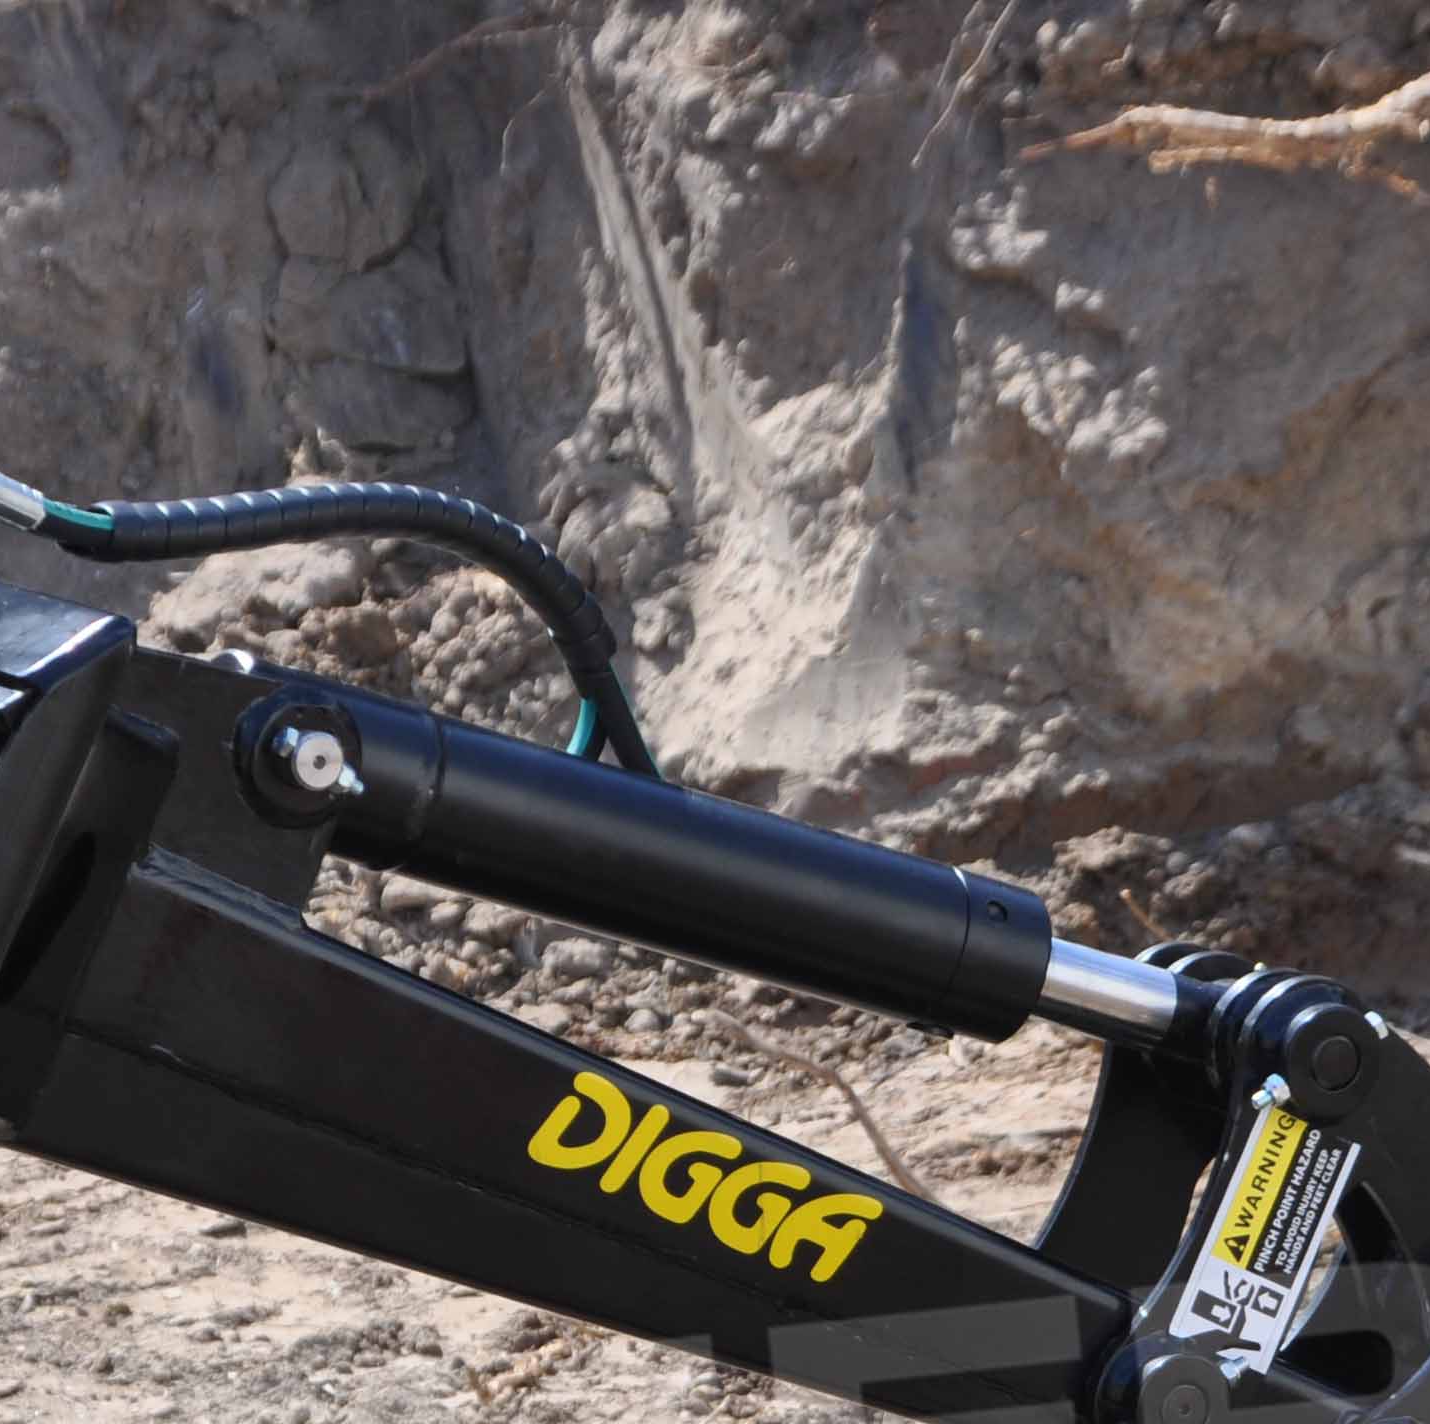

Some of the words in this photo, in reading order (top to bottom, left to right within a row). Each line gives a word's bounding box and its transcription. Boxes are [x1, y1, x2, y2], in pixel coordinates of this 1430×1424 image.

[527, 1071, 884, 1283] DIGGA
[1234, 1114, 1296, 1228] WARNING
[1253, 1229, 1280, 1272] PINCH
[1273, 1185, 1298, 1229] POINT
[1291, 1129, 1321, 1186] HAZARD
[1275, 1250, 1288, 1266] TO
[1282, 1216, 1302, 1251] AVOID
[1296, 1177, 1318, 1216] INJURY
[1312, 1149, 1329, 1178] KEEP
[1283, 1235, 1306, 1274] HANDS
[1300, 1210, 1316, 1236] AND
[1310, 1183, 1327, 1210] FEET
[1321, 1148, 1342, 1184] CLEAR
